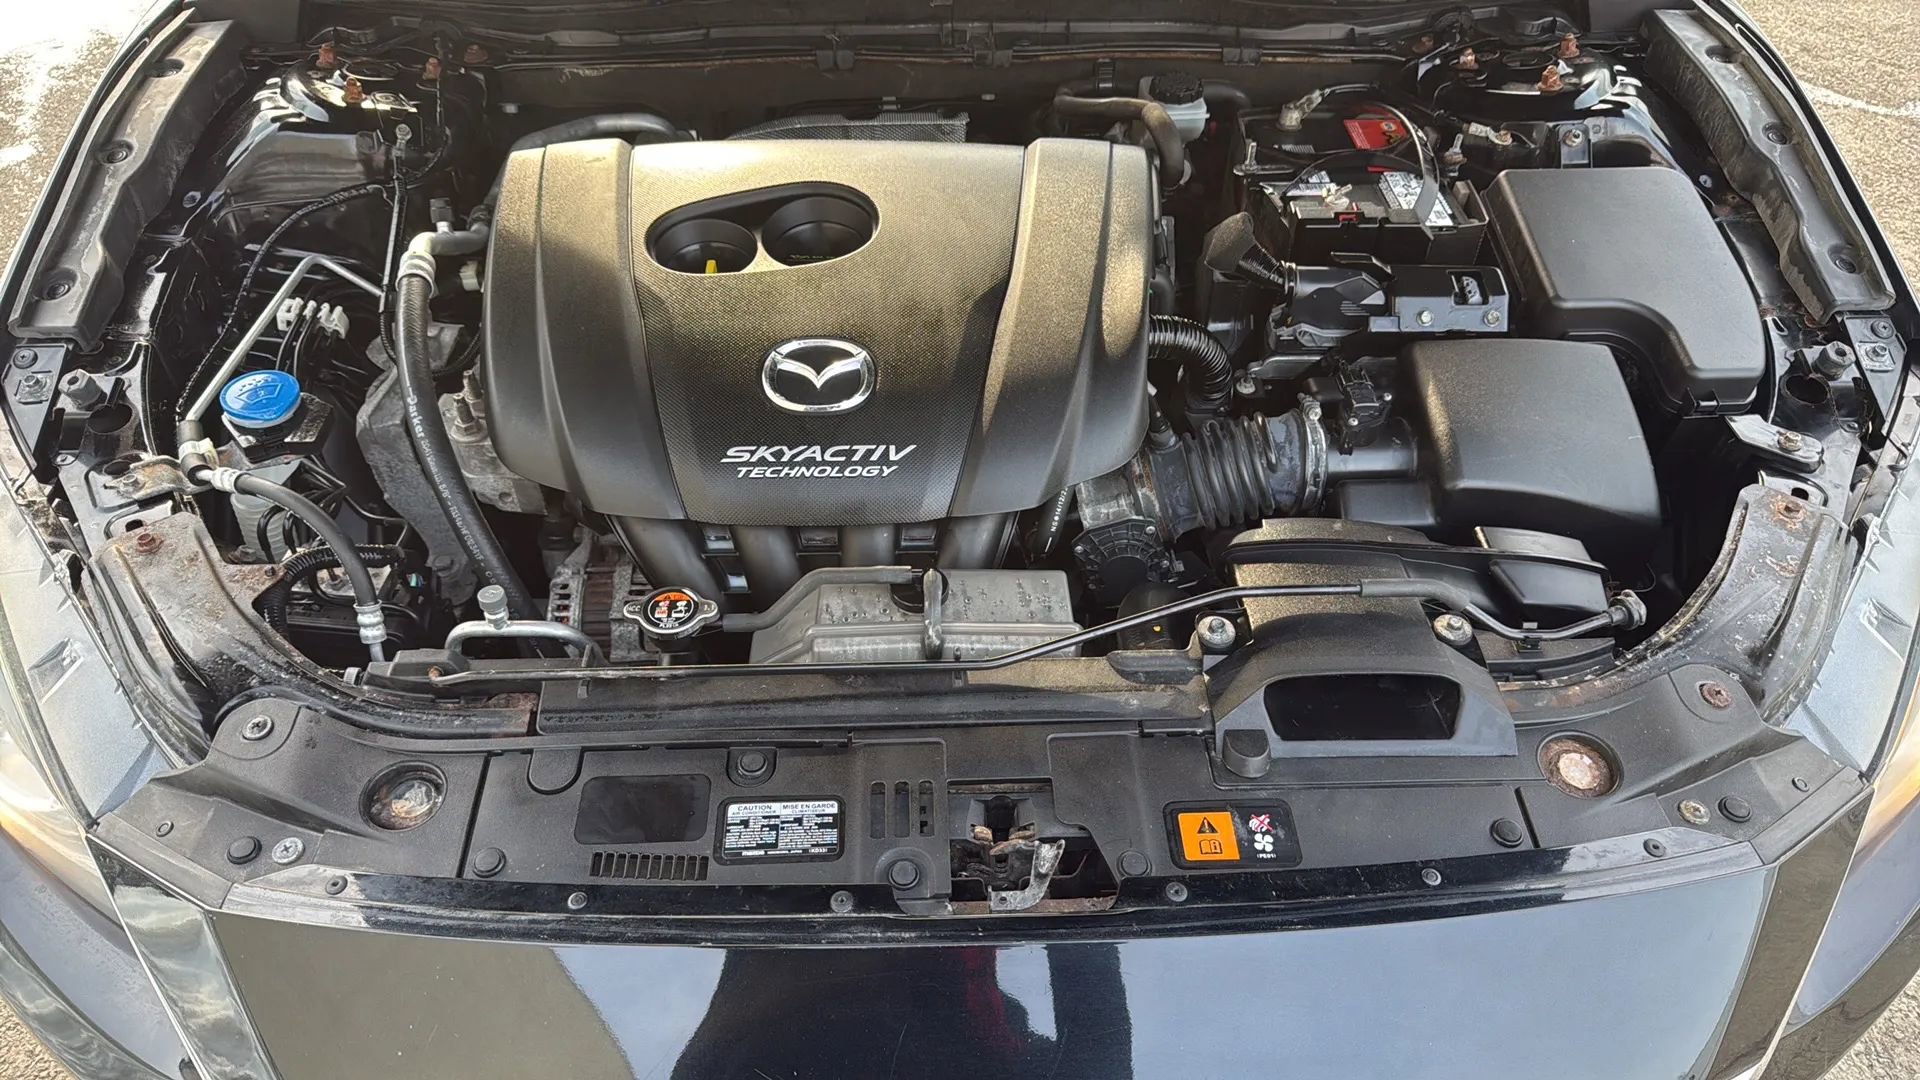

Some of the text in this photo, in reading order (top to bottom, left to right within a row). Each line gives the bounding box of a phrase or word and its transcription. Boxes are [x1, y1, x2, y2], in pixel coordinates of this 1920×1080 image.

[407, 393, 425, 438] Parker
[720, 444, 917, 462] SKYACTIV
[737, 465, 898, 478] TECHNOLOGY
